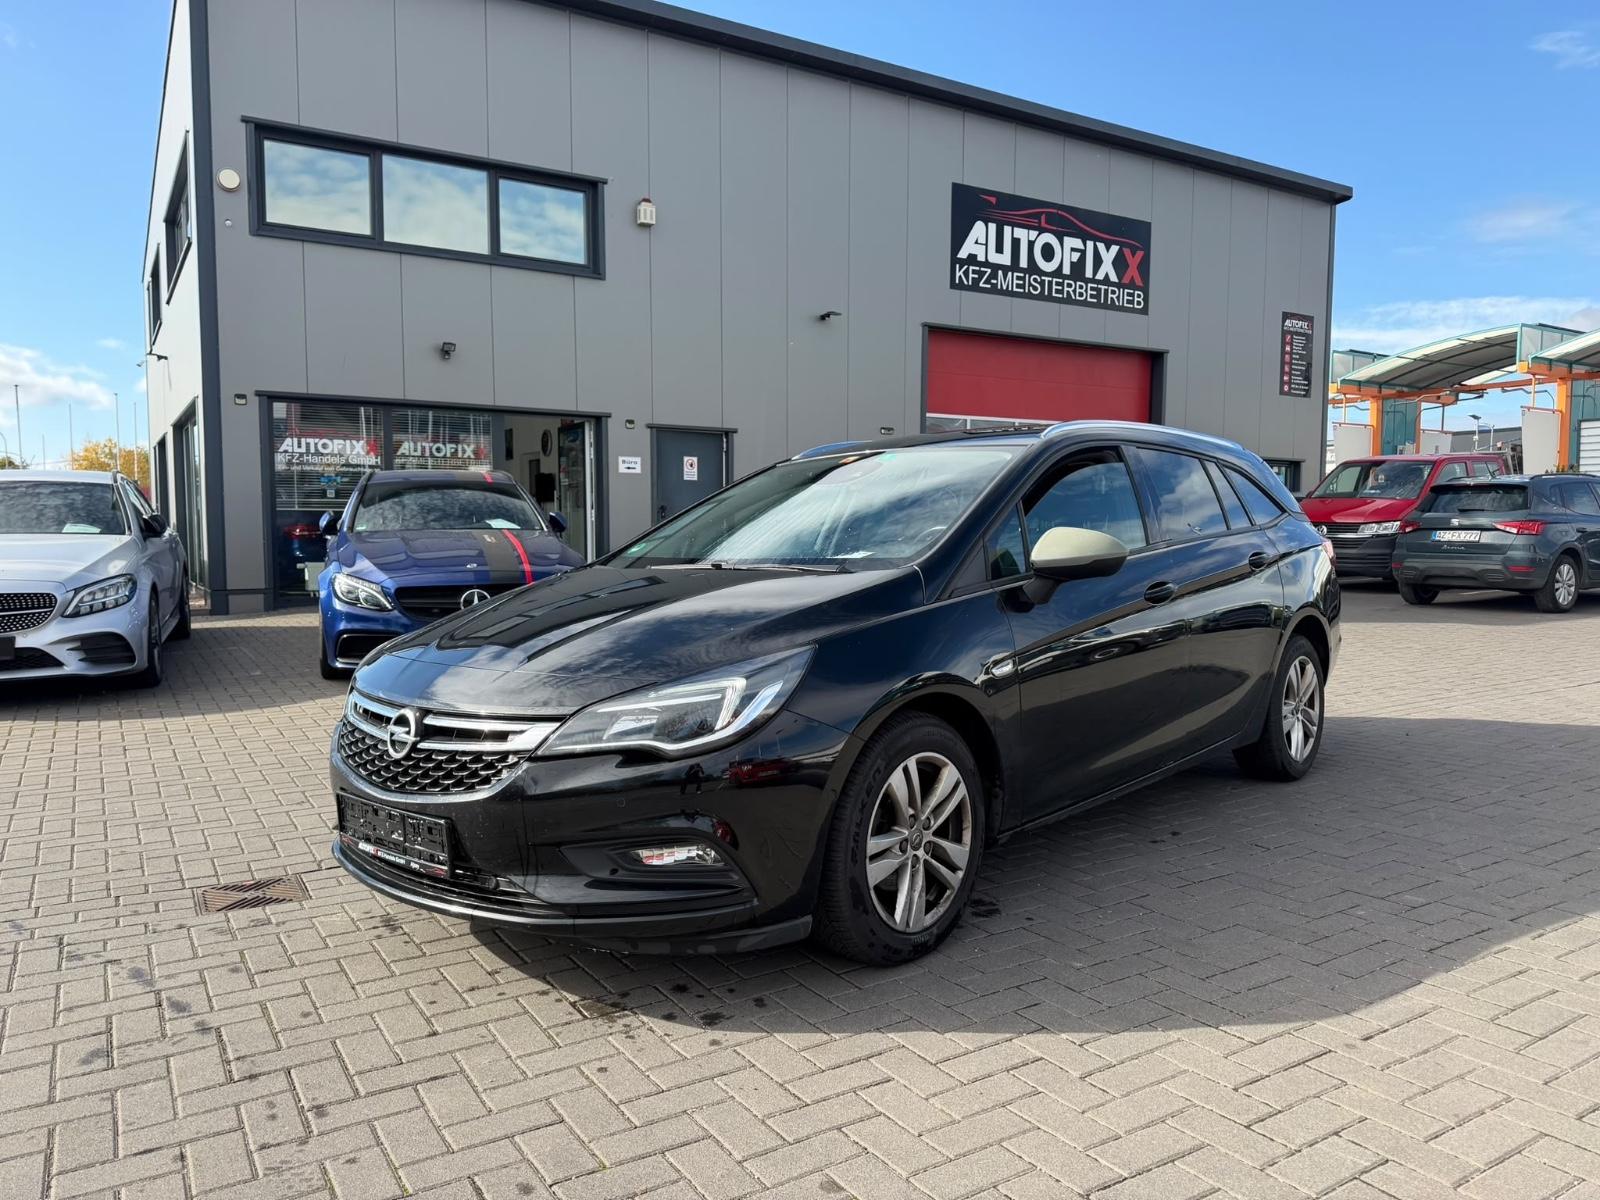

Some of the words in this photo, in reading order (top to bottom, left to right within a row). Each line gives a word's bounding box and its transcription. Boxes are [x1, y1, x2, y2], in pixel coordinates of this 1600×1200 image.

[956, 220, 1145, 287] AUTOFIXX
[956, 264, 1145, 309] KFZ-MEISTERBETRIEB
[278, 453, 346, 465] KFZ-Handels
[348, 455, 381, 466] GmbH
